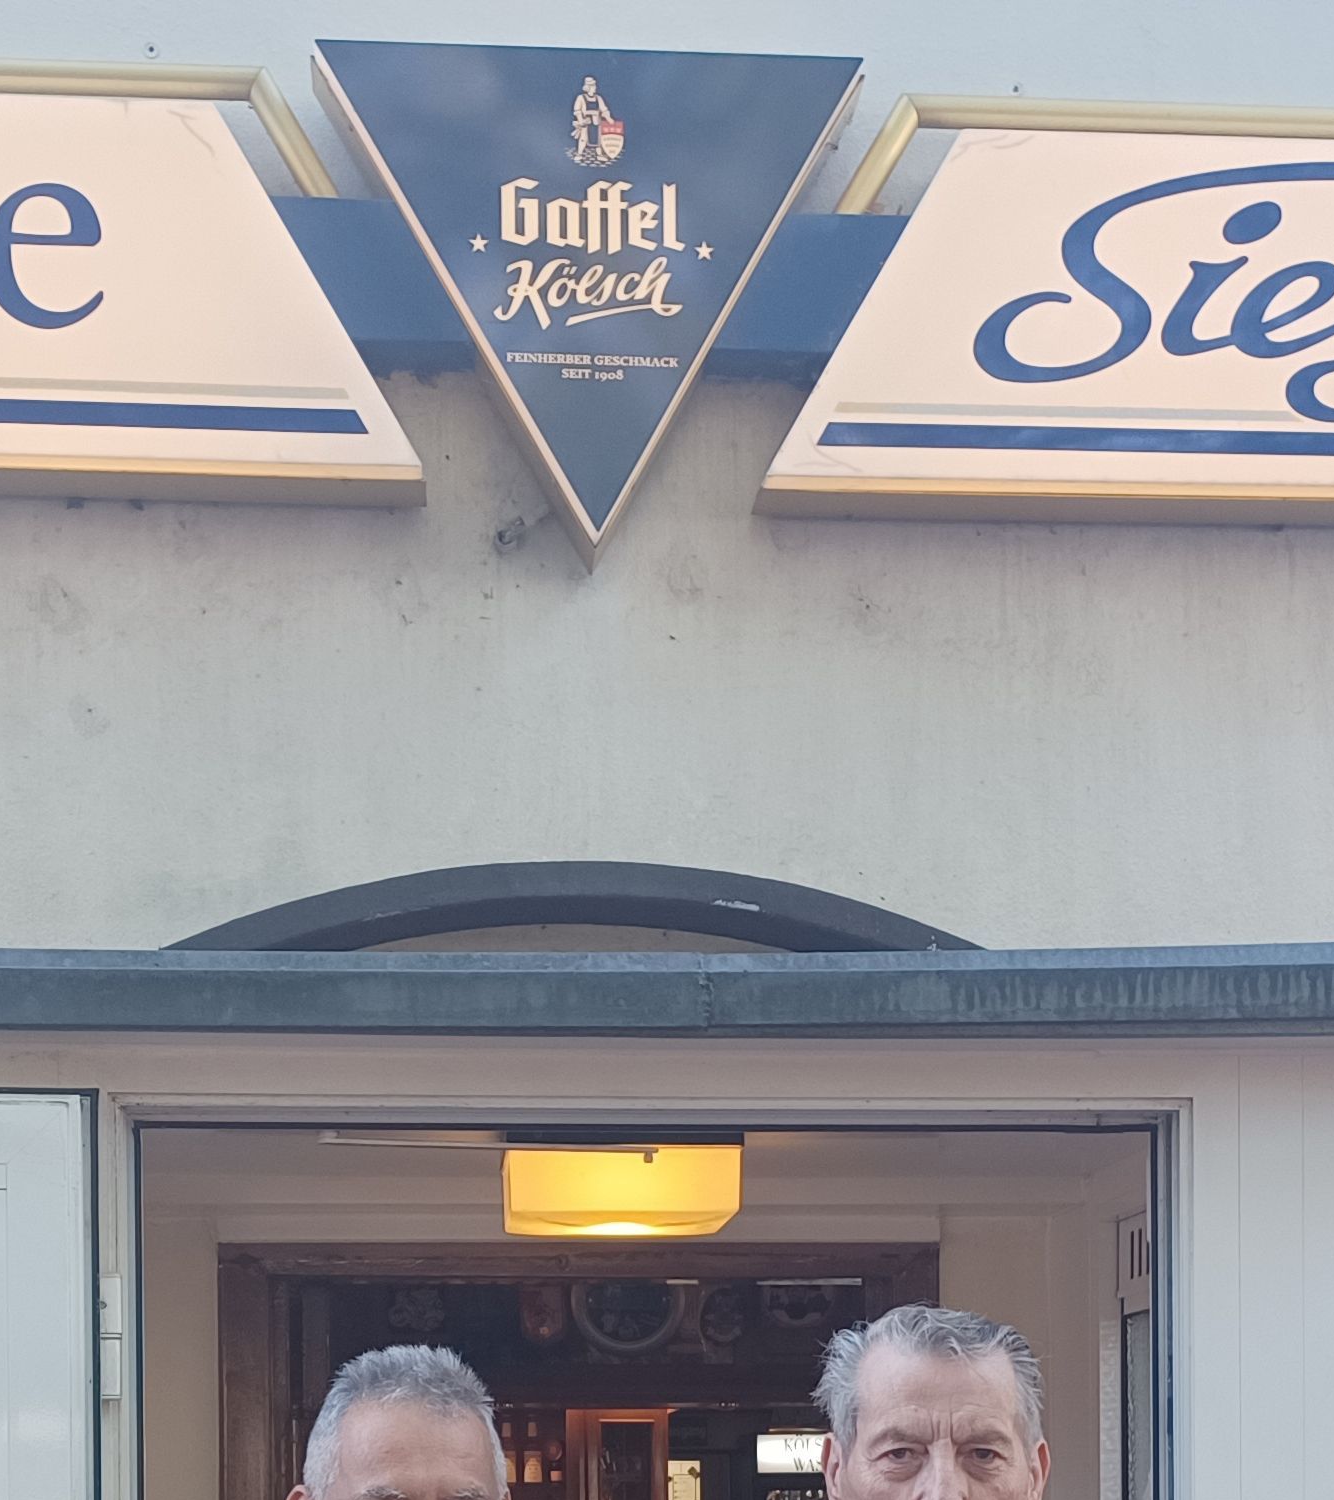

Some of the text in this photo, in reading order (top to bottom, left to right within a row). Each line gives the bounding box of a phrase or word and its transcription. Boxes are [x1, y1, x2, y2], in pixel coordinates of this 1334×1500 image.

[500, 177, 686, 255] Gaffel
[493, 256, 683, 330] Kölsch
[506, 352, 679, 368] FEINHERBER GESCHMACK
[561, 368, 624, 382] SEIT 1908
[784, 1433, 823, 1451] KÖLS
